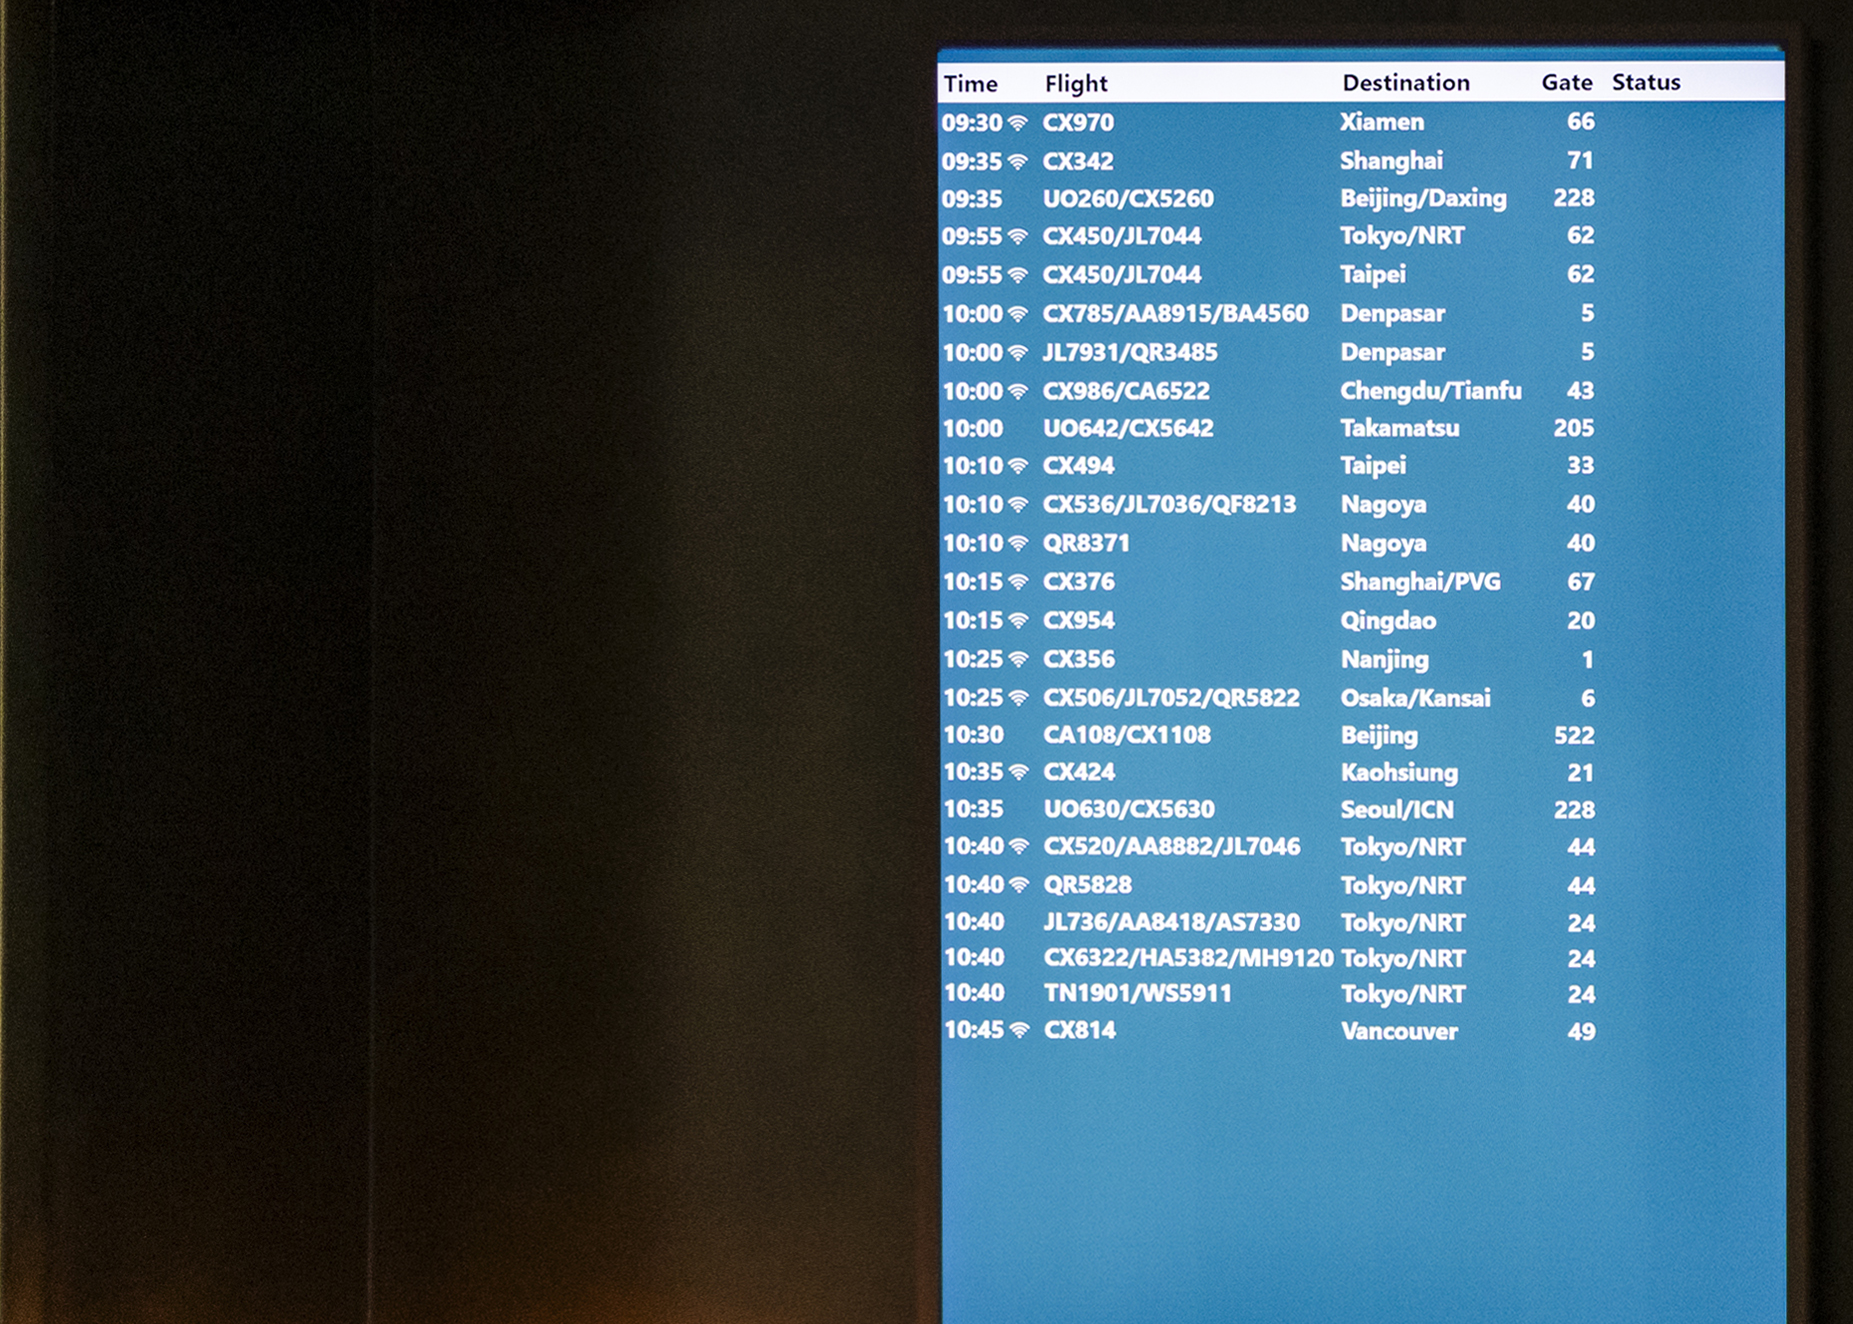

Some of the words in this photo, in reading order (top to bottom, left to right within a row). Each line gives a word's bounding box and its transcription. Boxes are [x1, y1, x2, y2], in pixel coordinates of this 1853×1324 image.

[944, 74, 997, 92] Time
[1047, 74, 1107, 97] Flight
[1344, 73, 1469, 91] Destination
[1543, 73, 1593, 91] Gate
[1613, 73, 1680, 91] Status
[941, 113, 1003, 132] 09:30
[1042, 112, 1115, 132] CX970
[1340, 110, 1425, 131] Xiamen
[1567, 111, 1596, 131] 66
[941, 152, 1003, 171] 09:35
[1042, 151, 1114, 171] CX342
[1340, 149, 1444, 176] Shanghai
[1567, 150, 1592, 170] 71
[941, 189, 1003, 209] 09:35
[1043, 188, 1215, 211] UO260/CX5260
[1341, 186, 1507, 213] Beijing/Daxing
[1553, 187, 1596, 207] 228
[941, 226, 1003, 246] 09:55
[1042, 226, 1203, 248] CX450/JL7044
[1339, 224, 1466, 250] Tokyo/NRT
[1567, 225, 1595, 244] 62
[941, 265, 1003, 285] 09:55
[1042, 264, 1203, 287] CX450/JL7044
[1339, 262, 1407, 289] Taipei
[1567, 264, 1595, 284] 62
[943, 304, 1004, 323] 10:00
[1042, 303, 1310, 325] CX785/AA8915/BA4560
[1341, 303, 1447, 328] Denpasar
[1581, 303, 1595, 322] 5
[943, 342, 1004, 362] 10:00
[1042, 342, 1219, 364] JL7931/QR3485
[1341, 342, 1447, 367] Denpasar
[1581, 342, 1595, 361] 5
[943, 381, 1004, 401] 10:00
[1042, 381, 1210, 403] CX986/CA6522
[1340, 379, 1522, 406] Chengdu/Tianfu
[1566, 380, 1595, 400] 43
[943, 418, 1004, 438] 10:00
[1044, 418, 1214, 440] UO642/CX5642
[1339, 416, 1460, 438] Takamatsu
[1553, 418, 1595, 438] 205
[943, 455, 1004, 475] 10:10
[1042, 455, 1116, 475] CX494
[1340, 453, 1407, 480] Taipei
[1567, 455, 1595, 475] 33
[943, 494, 1004, 514] 10:10
[1042, 494, 1297, 516] CX536/JL7036/QF8213
[1341, 494, 1427, 519] Nagoya
[1566, 494, 1596, 514] 40
[943, 533, 1004, 553] 10:10
[1043, 533, 1129, 555] QR8371
[1341, 533, 1427, 558] Nagoya
[1566, 533, 1596, 553] 40
[943, 571, 1004, 591] 10:15
[1043, 571, 1116, 591] CX376
[1340, 570, 1501, 597] Shanghai/PVG
[1567, 572, 1596, 591] 67
[943, 610, 1004, 630] 10:15
[1043, 610, 1116, 630] CX954
[1340, 609, 1437, 636] Qingdao
[1567, 611, 1596, 630] 20
[943, 649, 1004, 669] 10:25
[1043, 649, 1116, 669] CX356
[1341, 648, 1430, 674] Nanjing
[1582, 649, 1593, 669] 1
[944, 687, 1004, 707] 10:25
[1043, 687, 1300, 710] CX506/JL7052/QR5822
[1340, 686, 1491, 710] Osaka/Kansai
[1581, 688, 1596, 708] 6
[944, 724, 1005, 744] 10:30
[1043, 724, 1212, 747] CA108/CX1108
[1341, 723, 1419, 750] Beijing
[1554, 725, 1595, 745] 522
[944, 761, 1004, 781] 10:35
[1043, 761, 1117, 782] CX424
[1341, 760, 1459, 788] Kaohsiung
[1567, 763, 1593, 782] 21
[944, 799, 1004, 818] 10:35
[1044, 799, 1216, 821] UO630/CX5630
[1341, 798, 1454, 822] Seoul/ICN
[1554, 800, 1596, 820] 228
[944, 836, 1005, 855] 10:40
[1043, 836, 1302, 858] CX520/AA8882/JL7046
[1340, 835, 1467, 862] Tokyo/NRT
[1567, 837, 1597, 857] 44
[944, 874, 1005, 894] 10:40
[1043, 874, 1133, 896] QR5828
[1340, 874, 1467, 901] Tokyo/NRT
[1567, 876, 1597, 895] 44
[944, 911, 1005, 931] 10:40
[1043, 911, 1301, 934] JL736/AA8418/AS7330
[1340, 911, 1467, 938] Tokyo/NRT
[1567, 913, 1597, 933] 24
[944, 947, 1005, 967] 10:40
[1044, 947, 1335, 970] CX6322/HA5382/MH9120
[1340, 946, 1467, 973] Tokyo/NRT
[1567, 949, 1597, 968] 24
[944, 982, 1005, 1002] 10:40
[1043, 982, 1231, 1005] TN1901/WS5911
[1340, 982, 1468, 1009] Tokyo/NRT
[1568, 984, 1597, 1004] 24
[945, 1019, 1005, 1039] 10:45
[1044, 1019, 1117, 1040] CX814
[1341, 1021, 1459, 1041] Vancouver
[1567, 1022, 1597, 1041] 49
